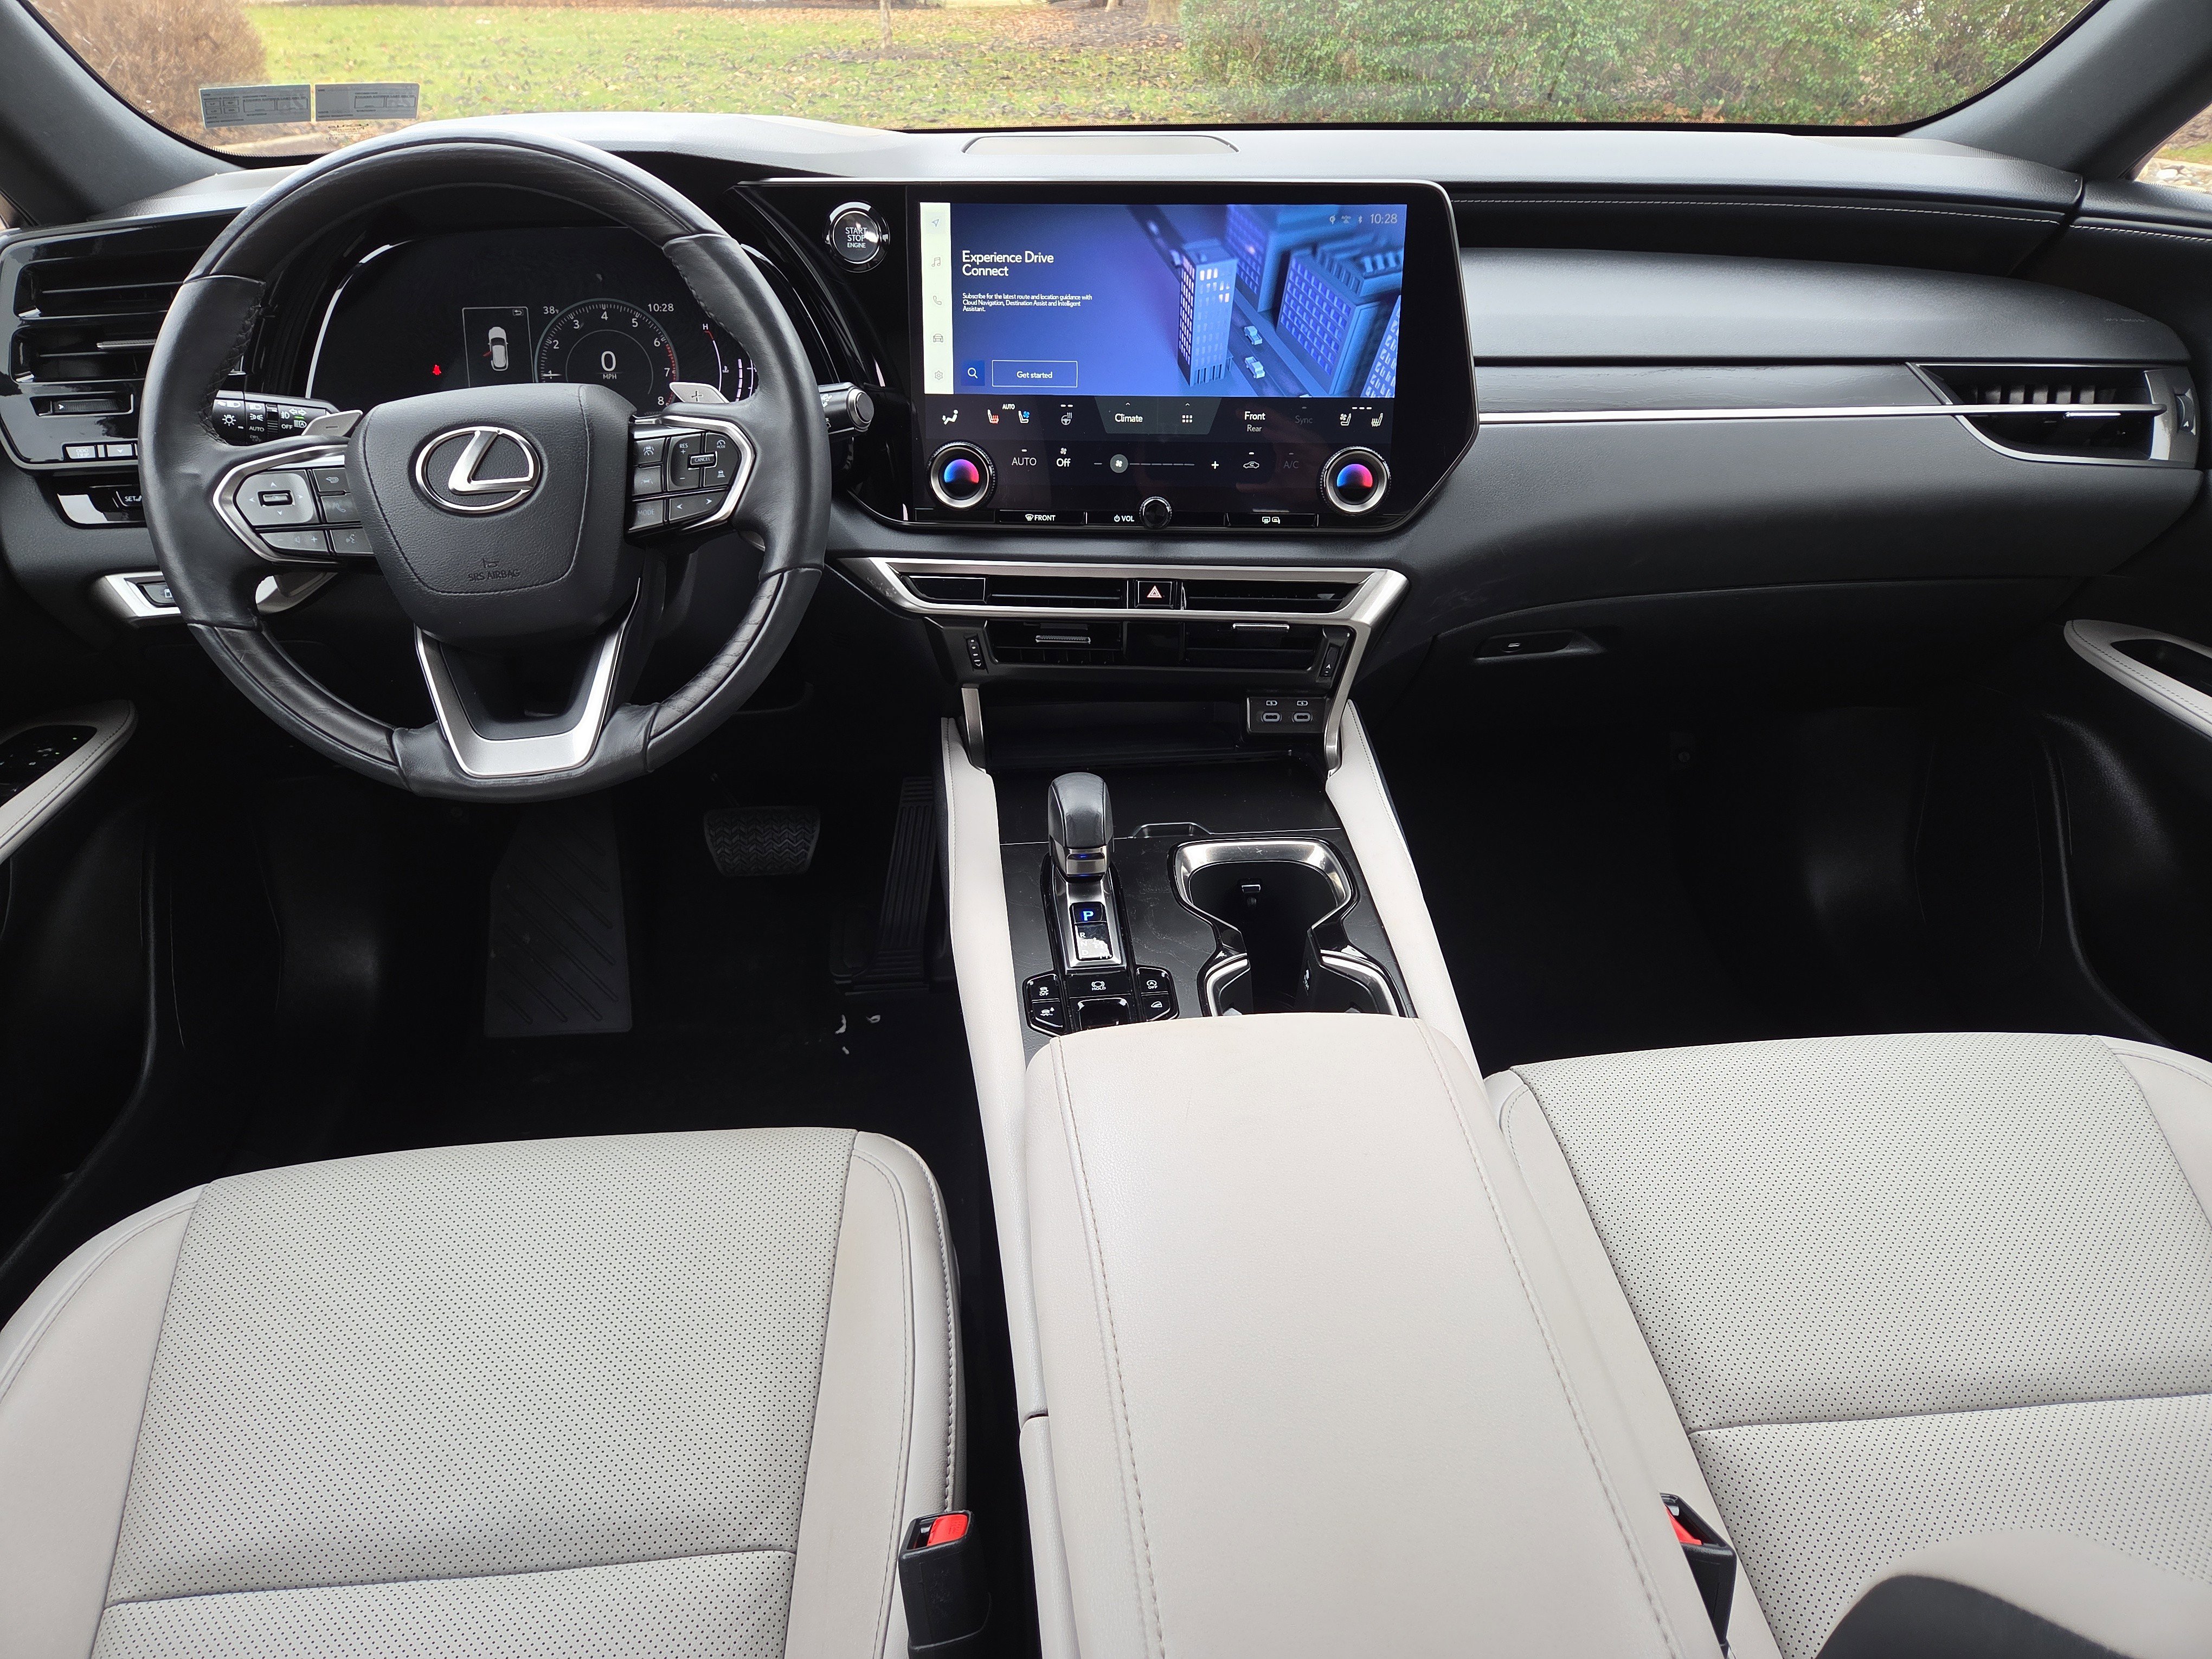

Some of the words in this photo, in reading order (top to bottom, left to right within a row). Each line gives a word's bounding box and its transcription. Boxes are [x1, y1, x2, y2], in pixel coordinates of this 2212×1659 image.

[1370, 213, 1398, 224] 10:28
[962, 250, 1023, 265] Experience
[1025, 250, 1054, 263] Drive
[962, 263, 1009, 276] Connect
[648, 303, 674, 312] 10:28
[601, 311, 608, 321] 4
[573, 319, 580, 329] 3
[632, 318, 638, 327] 5
[552, 339, 560, 349] 2
[653, 338, 661, 347] 6
[601, 351, 616, 372] 0
[664, 368, 671, 377] 7
[1017, 371, 1030, 379] Get
[1031, 371, 1053, 379] started
[658, 396, 665, 406] 8
[1115, 414, 1143, 423] Climate
[1244, 411, 1265, 421] Front
[1295, 415, 1313, 426] Sync
[1247, 425, 1262, 433] Rear
[1012, 457, 1037, 466] AUTO
[1056, 458, 1071, 467] Off
[1283, 460, 1299, 470] A/C
[467, 571, 485, 581] SRS
[487, 569, 520, 580] AIRBAG
[1083, 911, 1094, 921] P
